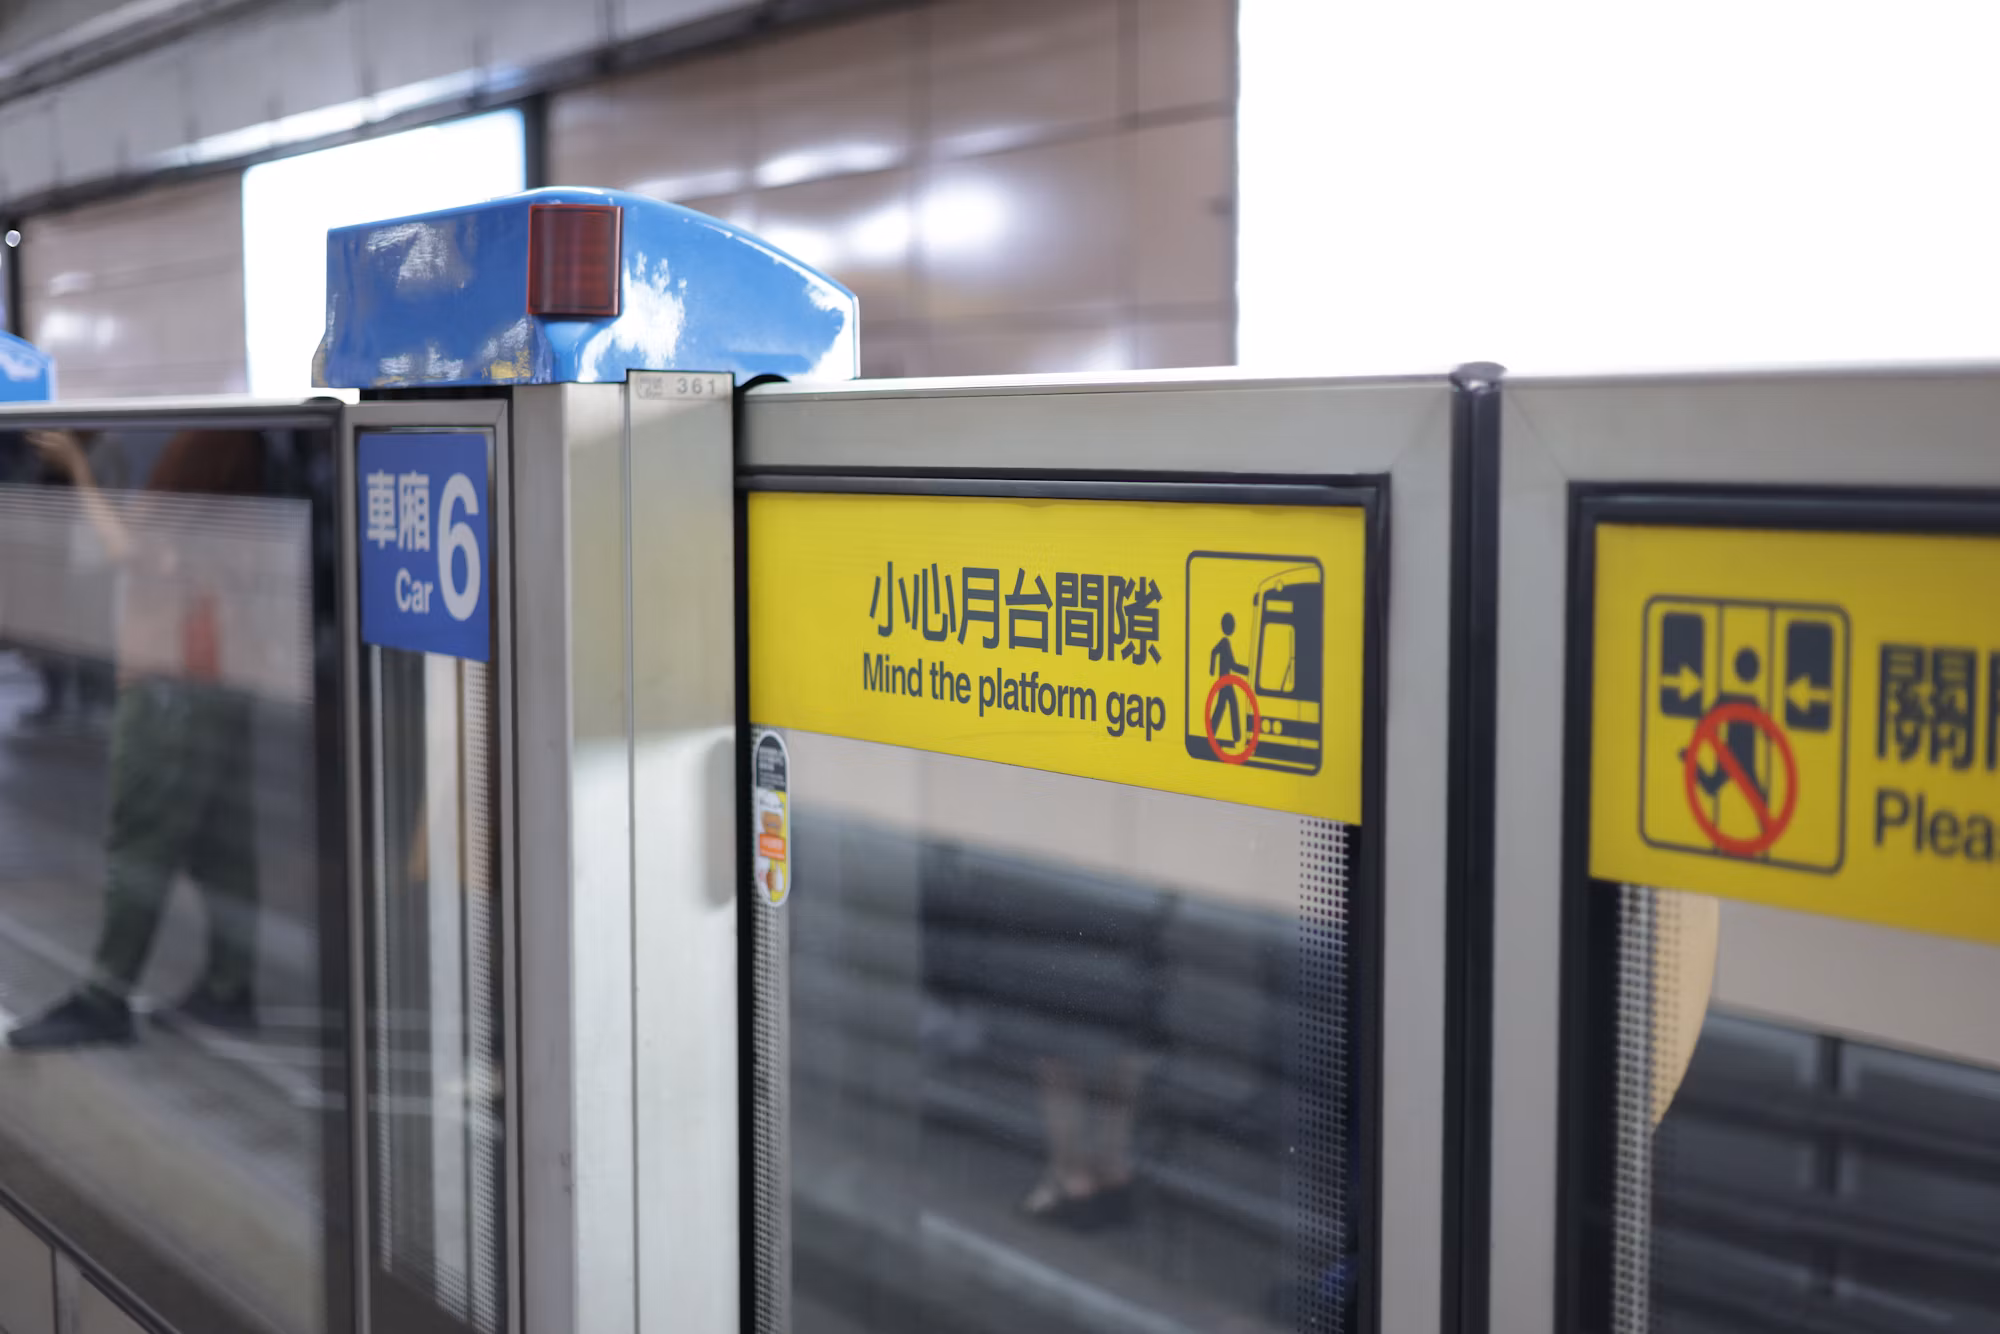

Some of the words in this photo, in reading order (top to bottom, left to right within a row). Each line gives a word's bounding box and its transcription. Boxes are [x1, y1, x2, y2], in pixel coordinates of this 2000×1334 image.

[677, 377, 715, 395] 361
[366, 468, 431, 552] 車廂
[437, 472, 482, 621] 6
[395, 567, 434, 614] Car
[869, 561, 1164, 665] 小心月台間隙
[863, 652, 923, 698] Mind
[930, 660, 972, 704] the
[979, 667, 1098, 722] platform
[1106, 691, 1167, 741] gap
[1874, 785, 2000, 863] Plea
